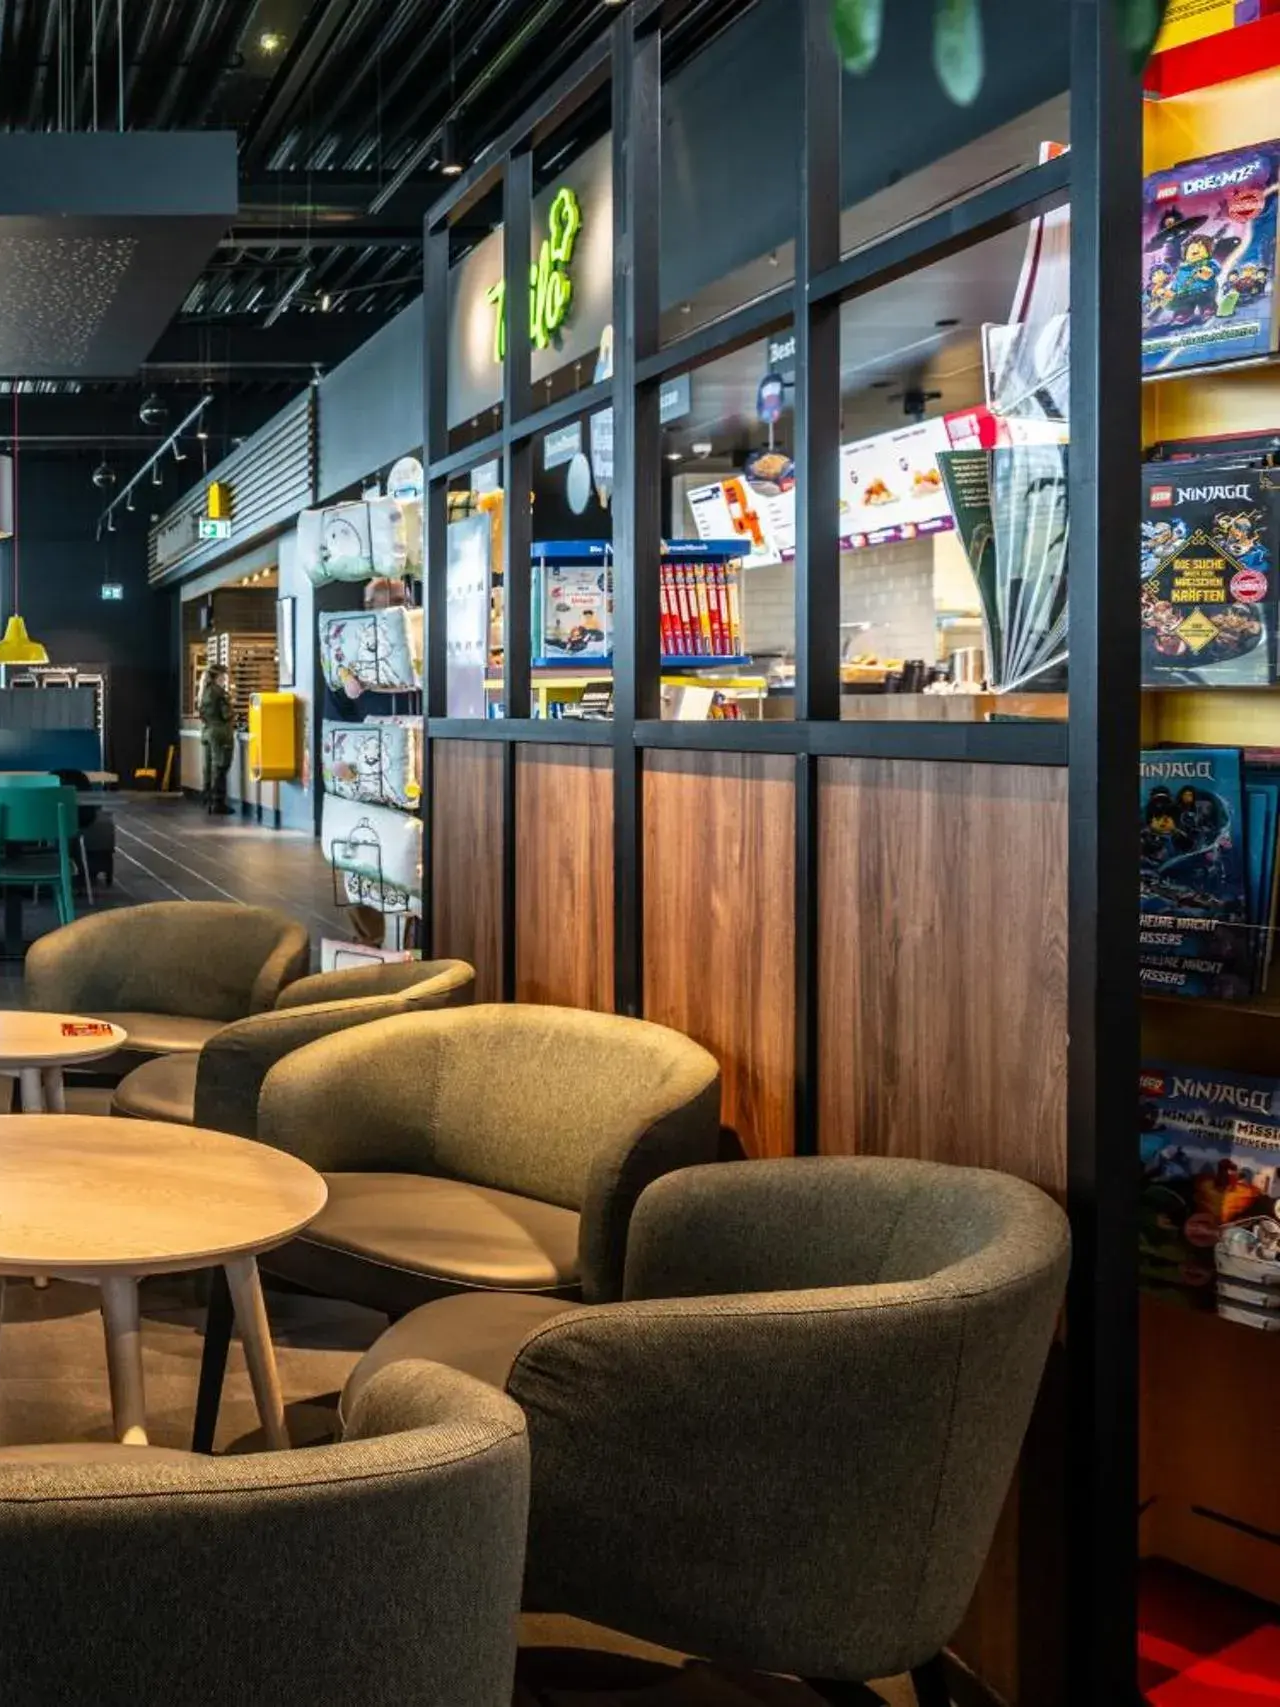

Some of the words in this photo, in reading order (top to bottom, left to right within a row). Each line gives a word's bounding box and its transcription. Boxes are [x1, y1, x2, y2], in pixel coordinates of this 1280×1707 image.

[1175, 484, 1254, 506] NINJAGO
[1194, 559, 1225, 570] SUCHE
[1171, 587, 1225, 602] KRÄFTEN
[1168, 1076, 1273, 1116] NINJAGO
